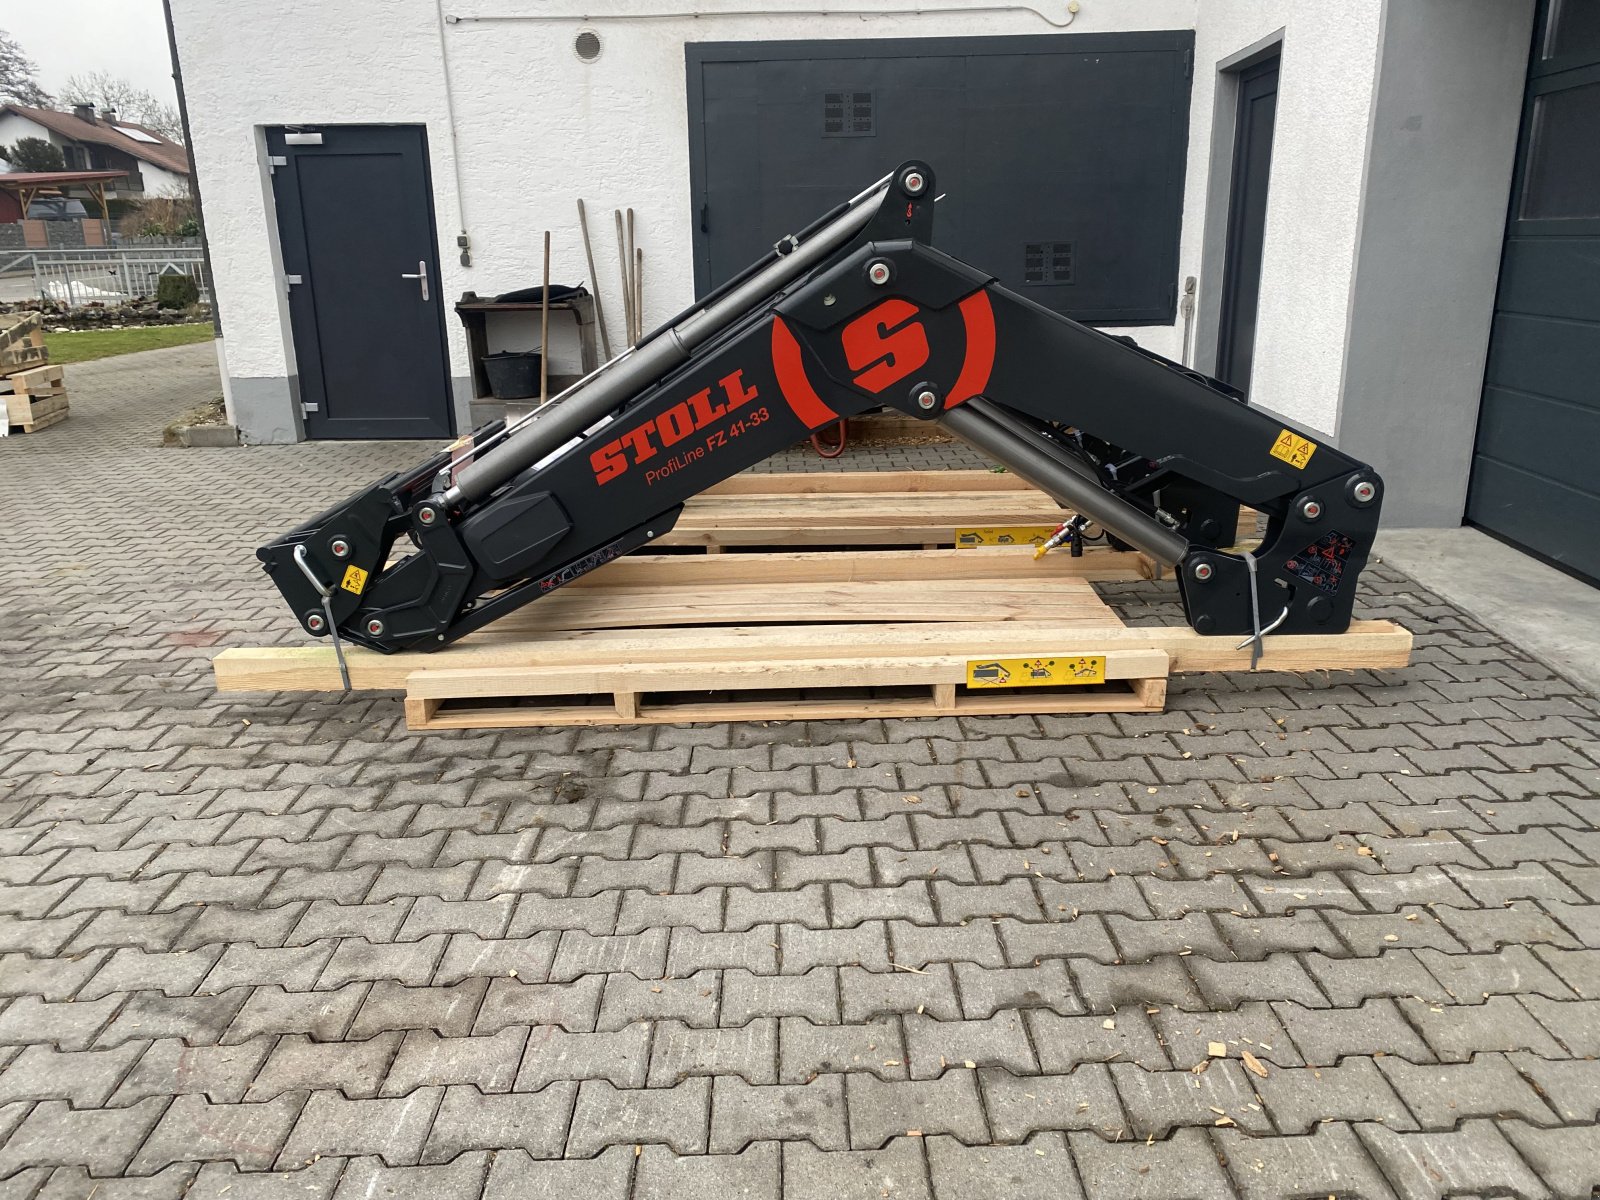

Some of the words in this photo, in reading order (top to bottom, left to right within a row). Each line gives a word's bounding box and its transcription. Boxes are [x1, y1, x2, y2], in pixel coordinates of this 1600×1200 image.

[842, 299, 930, 394] S
[589, 368, 759, 486] STOLL
[645, 446, 705, 486] ProfiLine
[705, 430, 728, 453] FZ
[729, 407, 770, 438] 41-33
